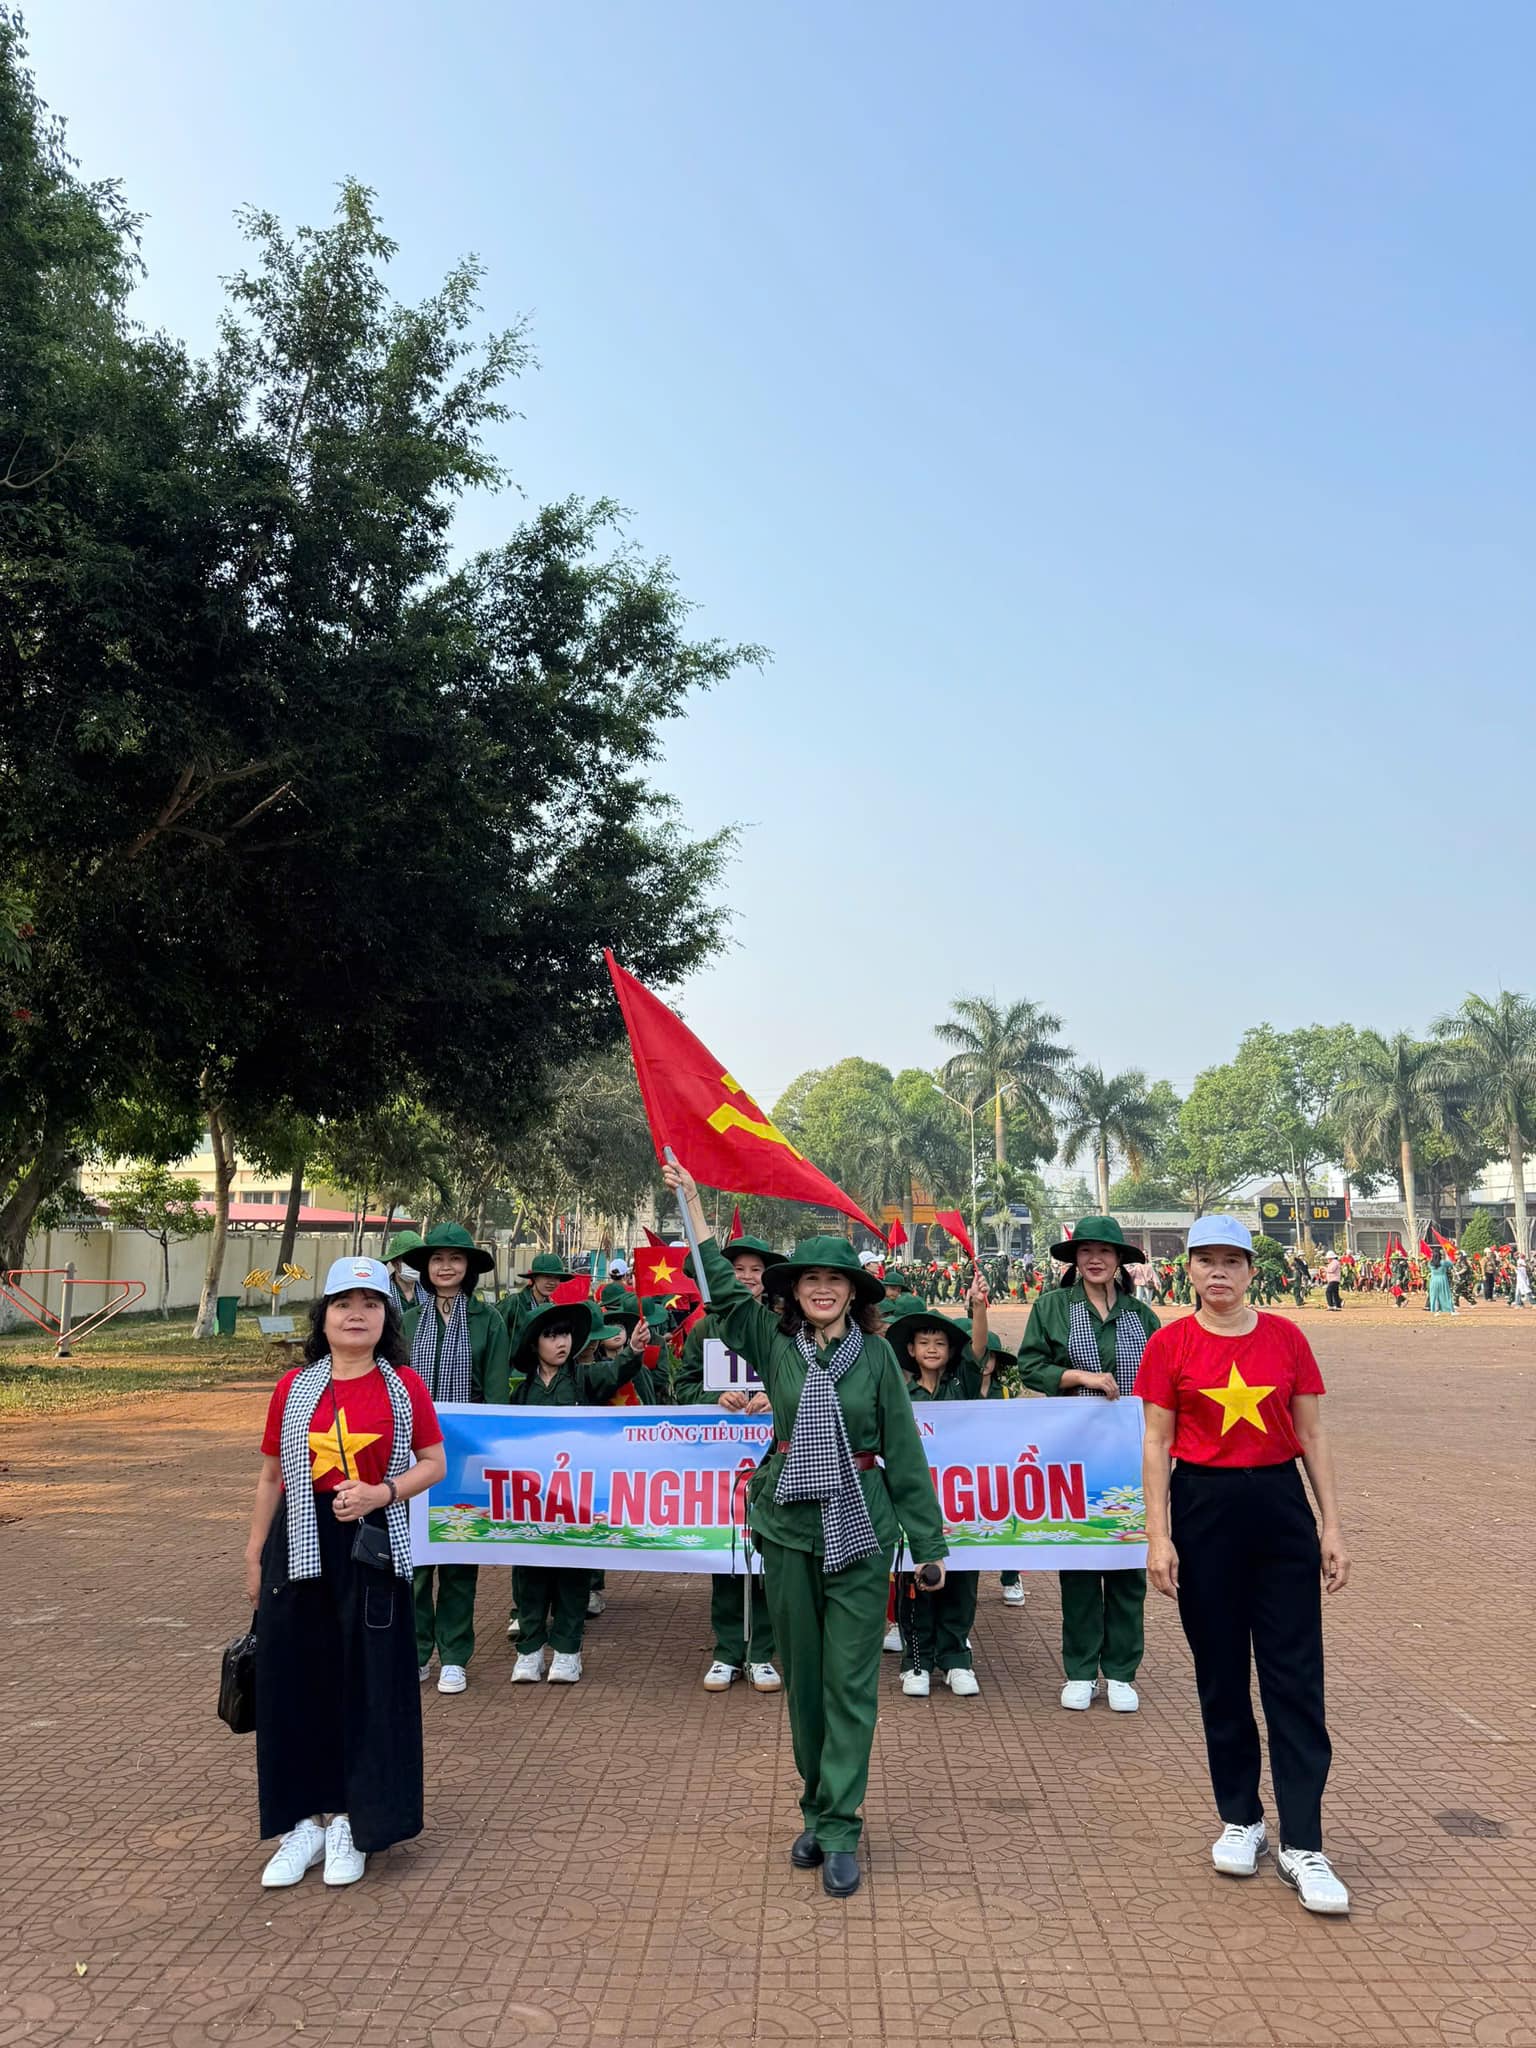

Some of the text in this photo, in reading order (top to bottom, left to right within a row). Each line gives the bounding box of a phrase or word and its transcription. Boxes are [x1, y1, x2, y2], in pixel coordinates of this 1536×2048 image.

[625, 1422, 697, 1442] TRƯỜNG
[701, 1421, 739, 1441] TIỂU
[484, 1445, 1088, 1539] TRẢI NGHIỆ GUỒN
